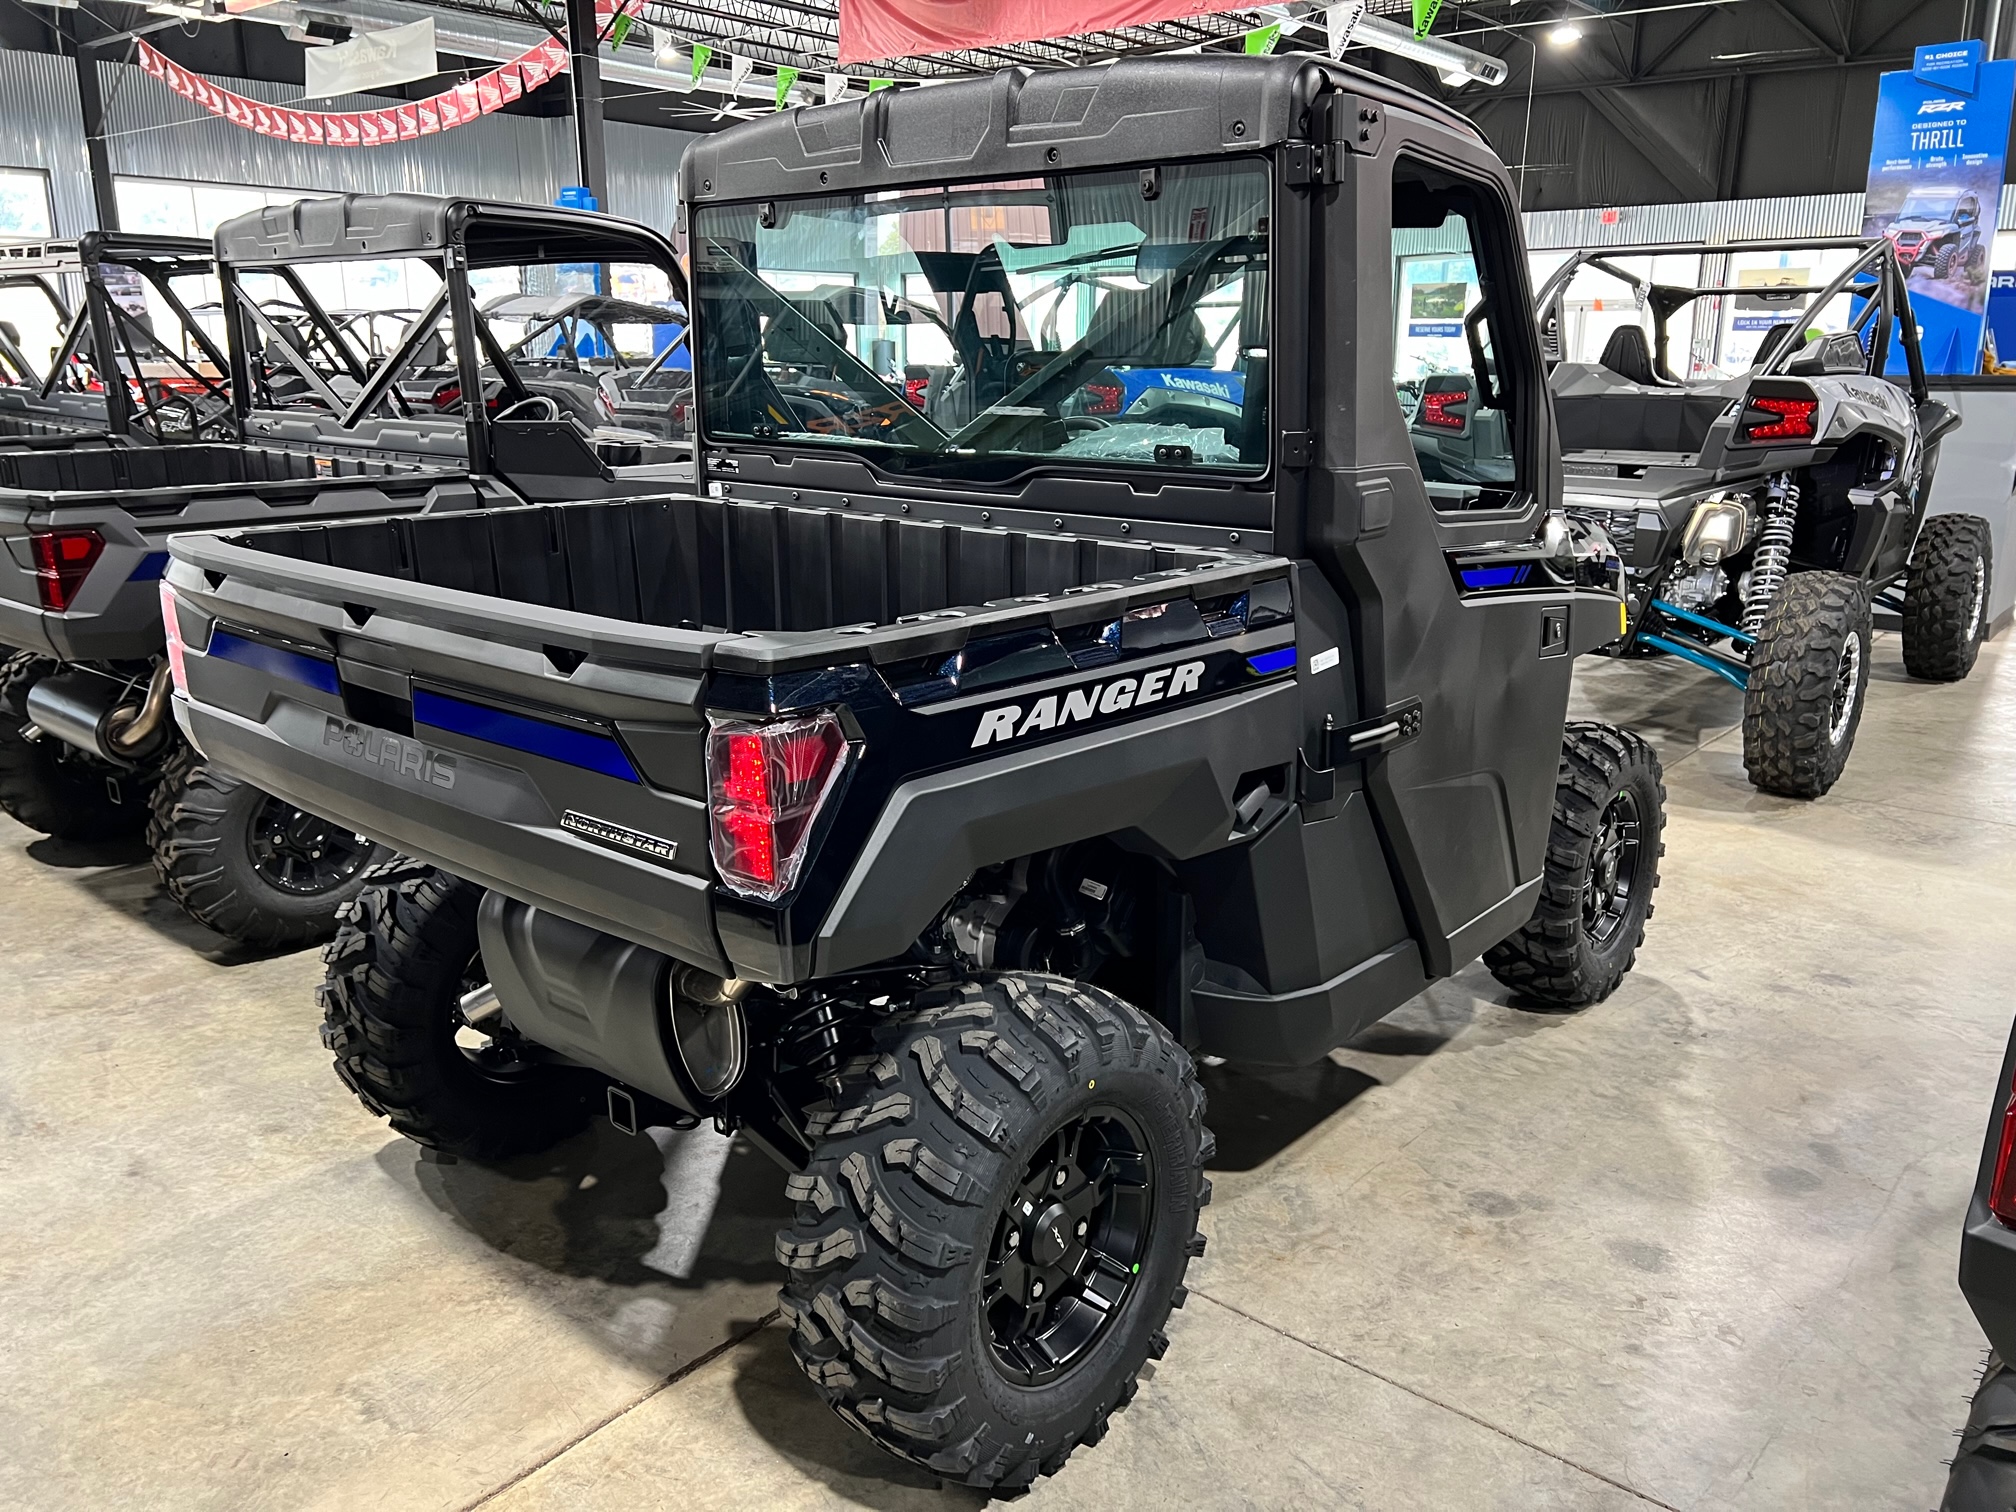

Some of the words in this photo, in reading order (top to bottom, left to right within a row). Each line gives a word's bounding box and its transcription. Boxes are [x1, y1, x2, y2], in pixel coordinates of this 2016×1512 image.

[1416, 0, 1440, 37] Kawa
[1935, 50, 1968, 60] CHOICE
[1910, 128, 1964, 151] THRILL
[1912, 121, 1954, 130] DESIGNED
[1160, 372, 1231, 399] Kawasaki
[970, 661, 1205, 748] RANGER
[323, 716, 456, 790] POLARIS
[565, 815, 670, 856] NORTHSTAR
